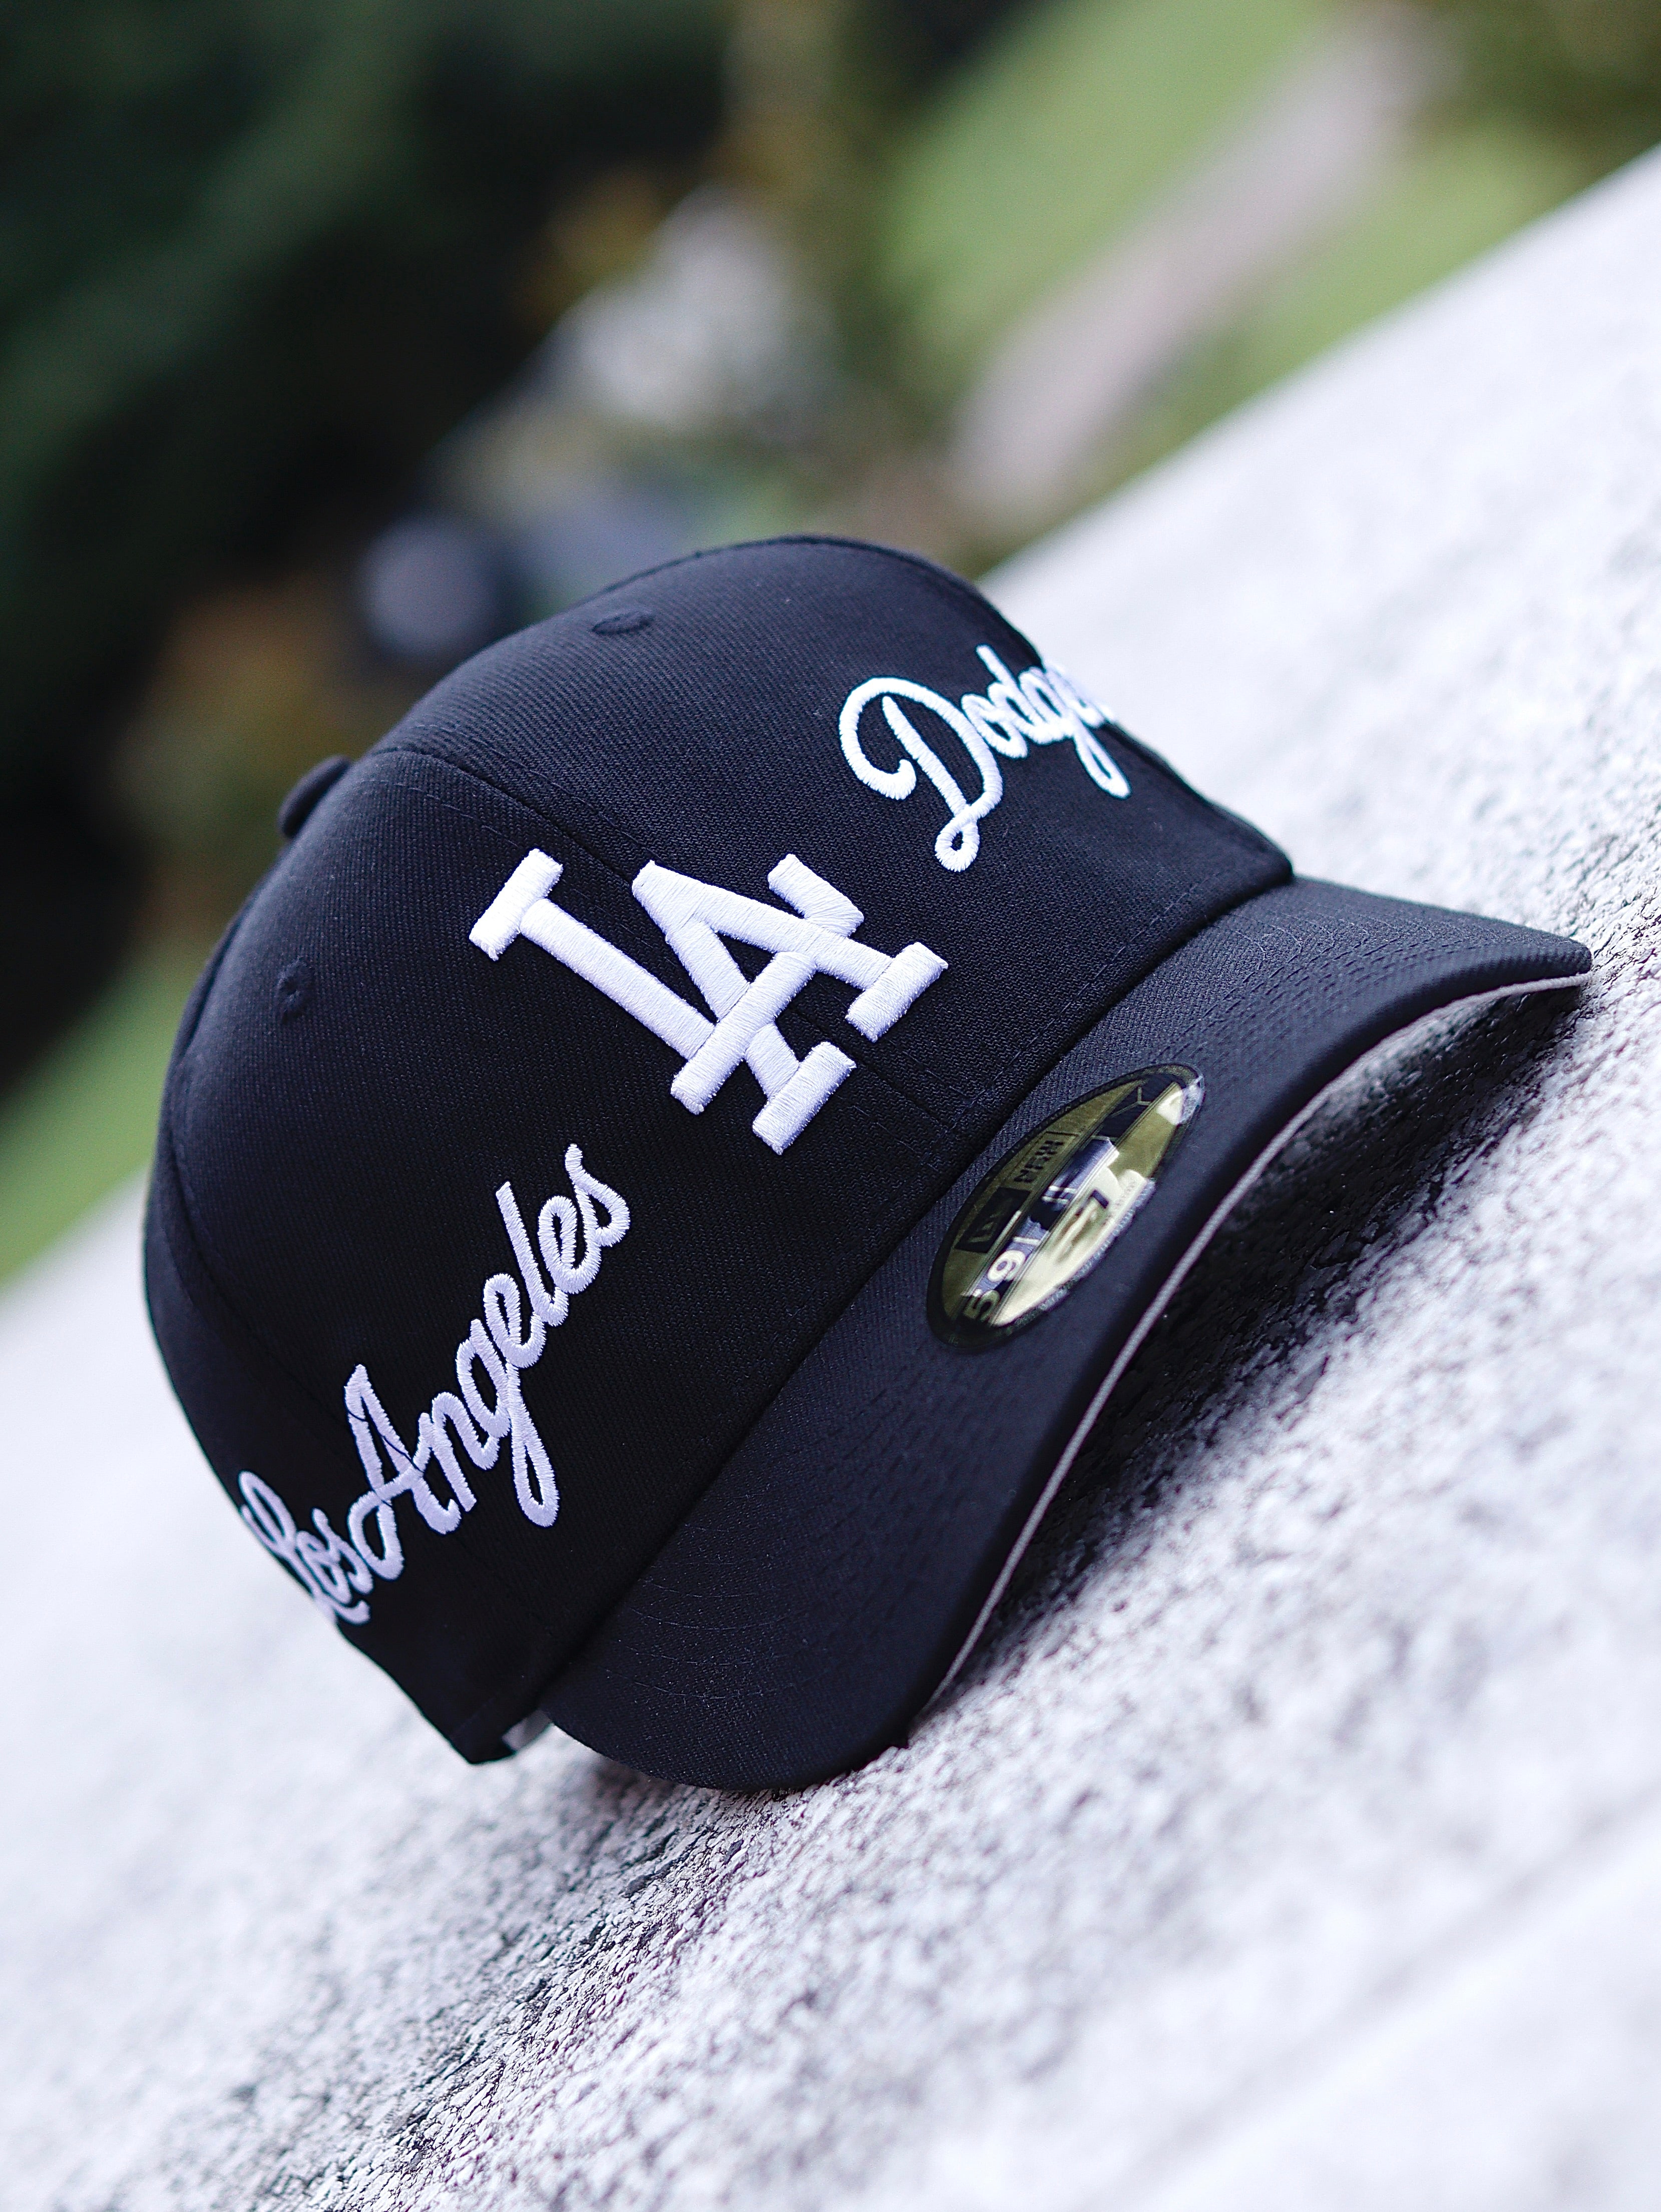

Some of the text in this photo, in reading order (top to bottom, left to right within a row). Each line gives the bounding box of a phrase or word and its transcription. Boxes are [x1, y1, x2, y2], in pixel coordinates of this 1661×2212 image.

[839, 644, 1130, 872] Dodge
[469, 848, 949, 1155] LA
[237, 1144, 631, 1624] Los Angeles
